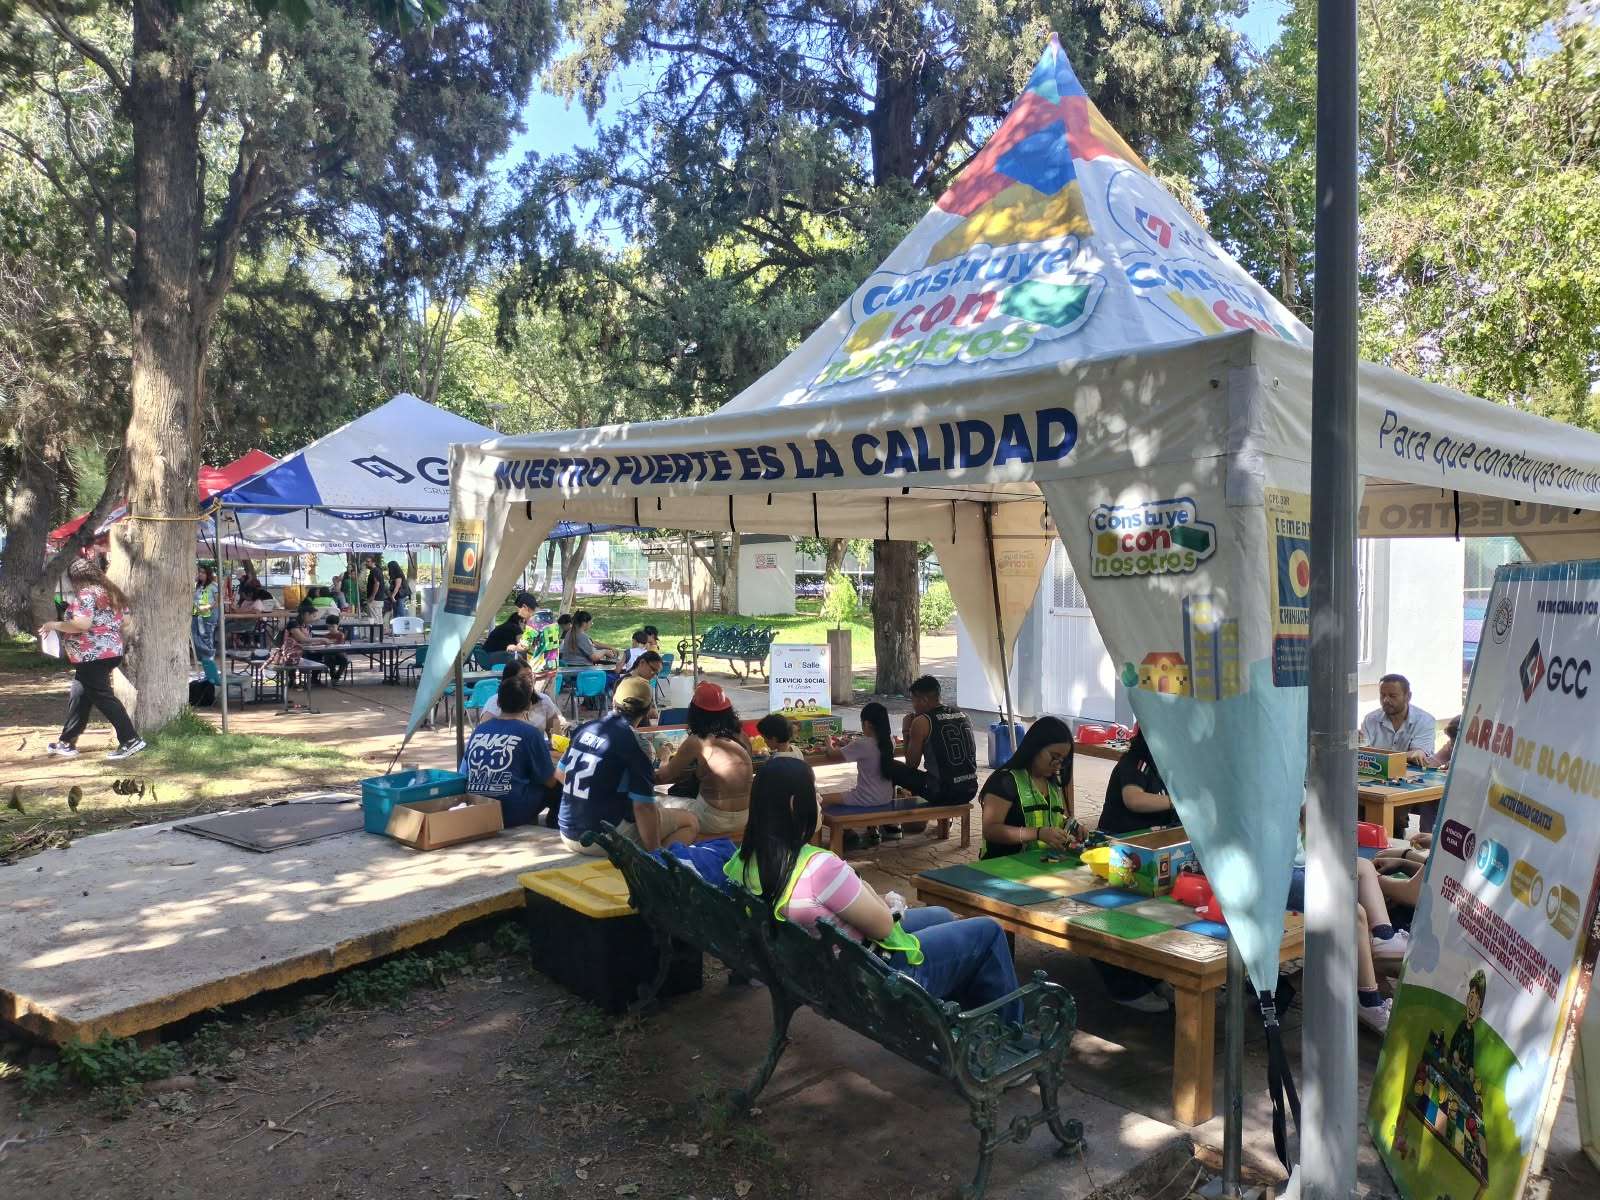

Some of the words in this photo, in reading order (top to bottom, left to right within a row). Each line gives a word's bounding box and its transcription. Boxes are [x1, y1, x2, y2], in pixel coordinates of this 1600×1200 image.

[862, 247, 1073, 315] Construye
[891, 289, 997, 339] con
[495, 457, 610, 489] NUESTRO
[612, 450, 732, 486] FUERTE
[734, 445, 785, 480] ES
[787, 438, 844, 479] LA
[852, 407, 1078, 476] CALIDAD
[1379, 408, 1431, 462] Para
[1433, 436, 1476, 476] que
[1474, 444, 1562, 493] construyas
[1095, 551, 1195, 573] nosotros
[1122, 529, 1171, 552] con
[1537, 600, 1583, 615] PATROCINADO
[1583, 601, 1599, 614] POR
[1547, 656, 1592, 699] GCC
[469, 733, 522, 751] FAKE
[1465, 704, 1514, 760] ÁREA
[1513, 736, 1537, 770] DE
[562, 748, 603, 800] 22
